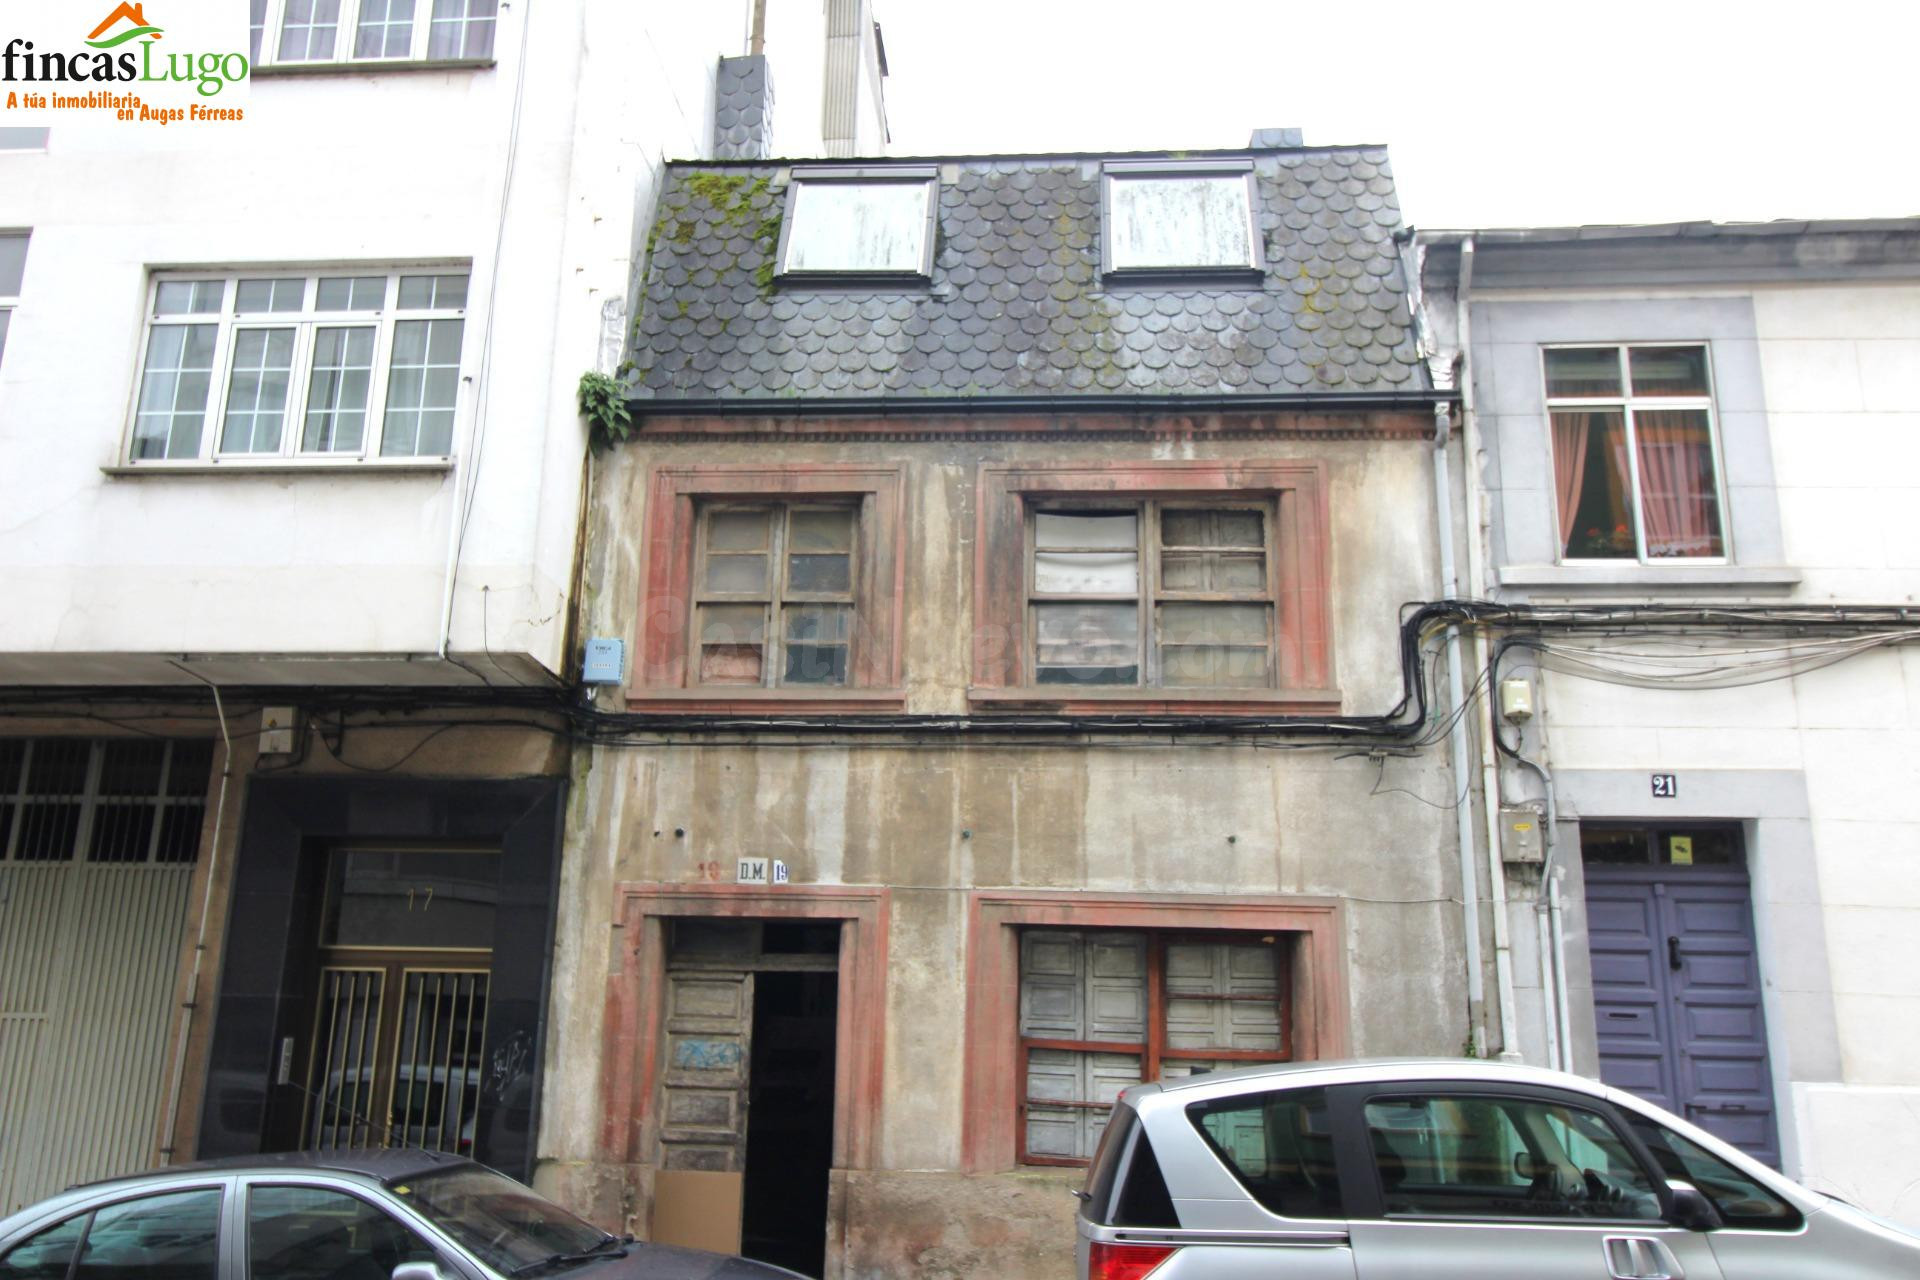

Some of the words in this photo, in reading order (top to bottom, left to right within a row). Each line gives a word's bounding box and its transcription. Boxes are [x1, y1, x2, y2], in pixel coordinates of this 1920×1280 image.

[1653, 775, 1675, 796] 21
[775, 863, 788, 881] 19
[406, 886, 433, 912] 17
